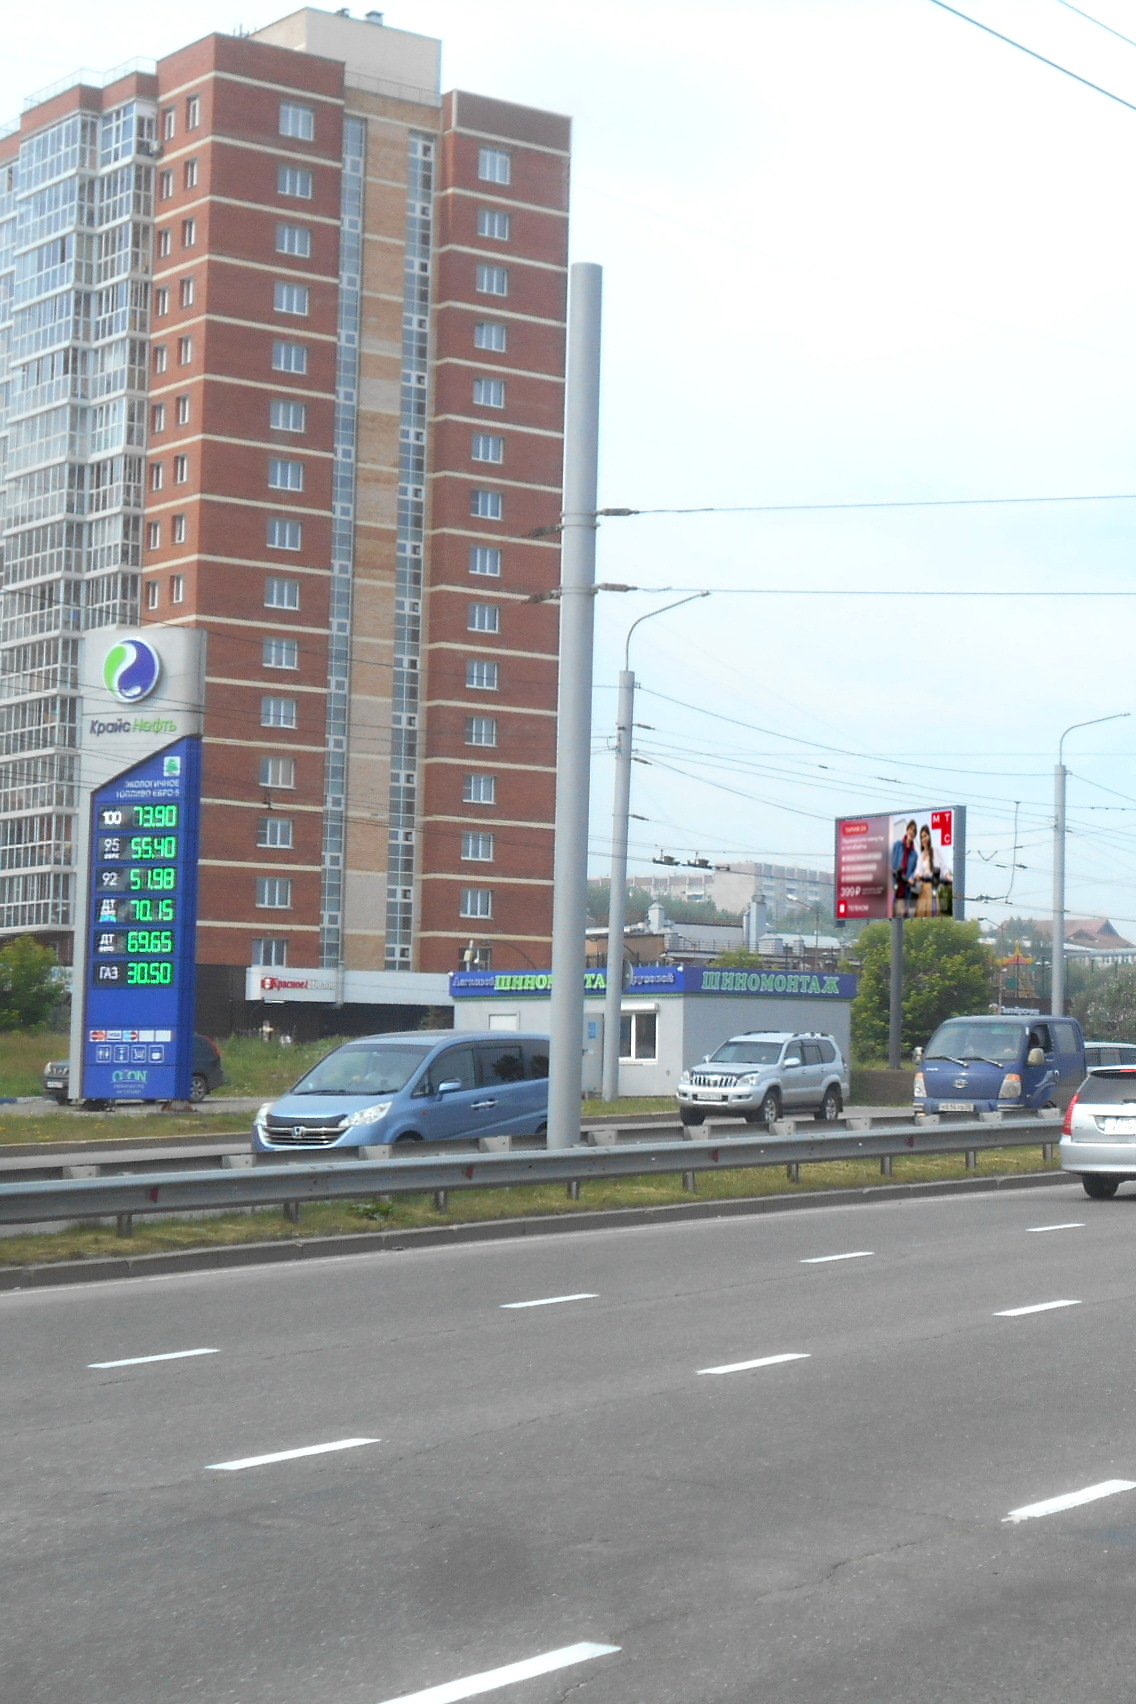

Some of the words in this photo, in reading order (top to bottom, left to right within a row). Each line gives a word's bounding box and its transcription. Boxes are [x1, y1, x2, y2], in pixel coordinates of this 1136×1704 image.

[89, 718, 131, 736] Крайс
[132, 717, 177, 734] Нефть
[102, 810, 122, 825] 100
[133, 805, 177, 828] 73.90
[104, 838, 120, 852] 95
[131, 836, 176, 859] 55.40
[102, 871, 118, 886] 92
[130, 867, 175, 890] 51.98
[130, 899, 173, 921] 70.15
[100, 934, 115, 945] ДТ
[127, 931, 172, 953] 69.65
[99, 966, 119, 980] ГАЗ
[127, 962, 171, 984] 30.50
[701, 971, 840, 994] ШИНОМОНТАЖ
